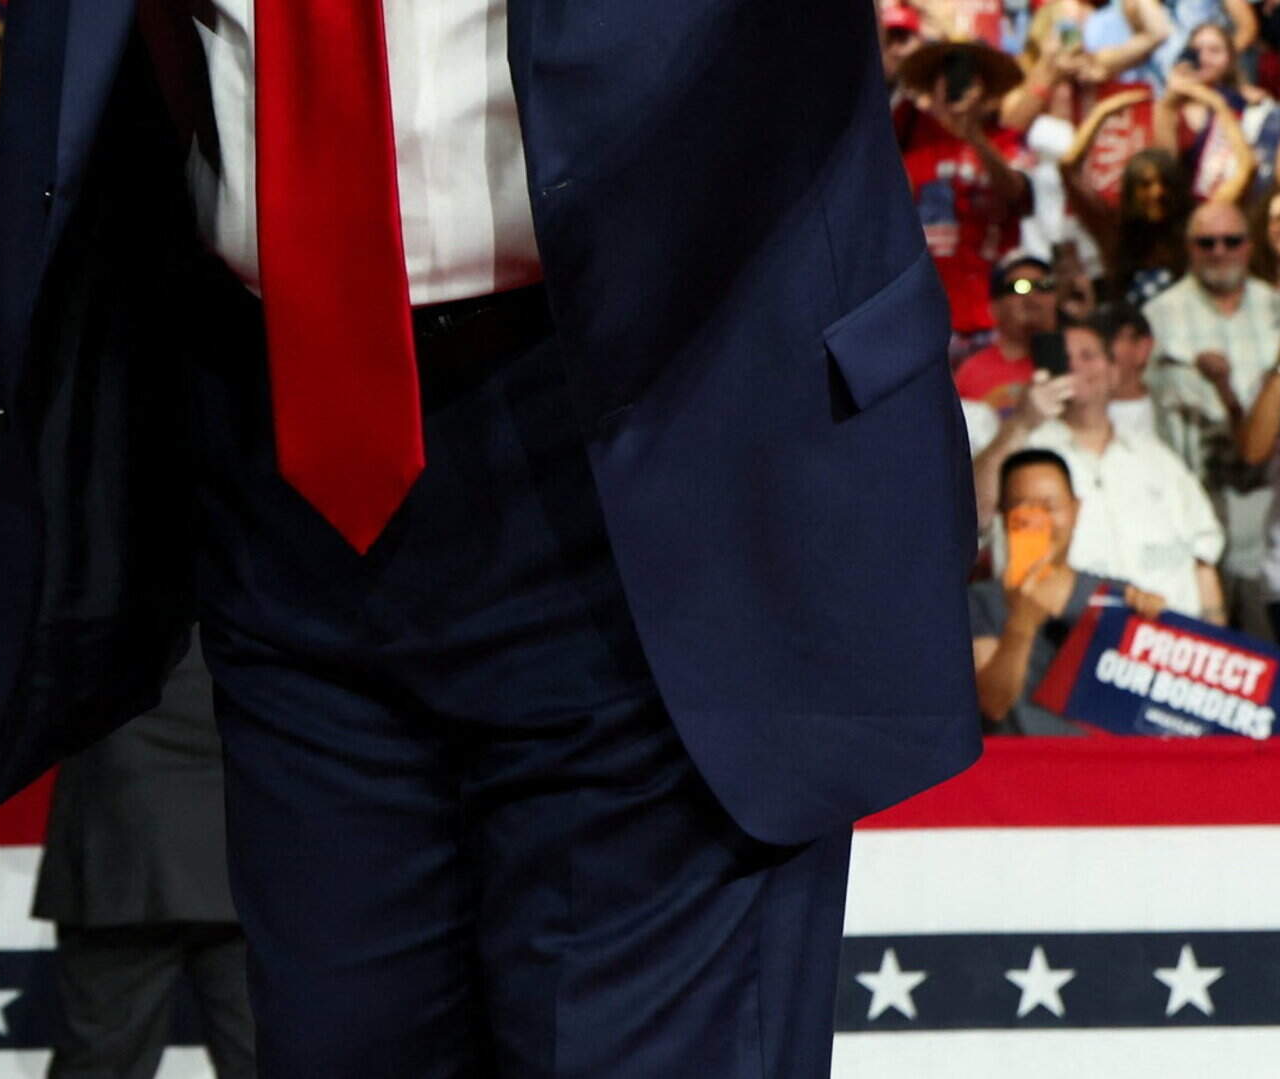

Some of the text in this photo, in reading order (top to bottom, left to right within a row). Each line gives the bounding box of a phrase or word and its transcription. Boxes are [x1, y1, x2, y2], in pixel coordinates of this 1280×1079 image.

[1096, 648, 1156, 698] OUR
[1150, 670, 1276, 739] BORDERS
[1130, 623, 1268, 698] PROTECT
